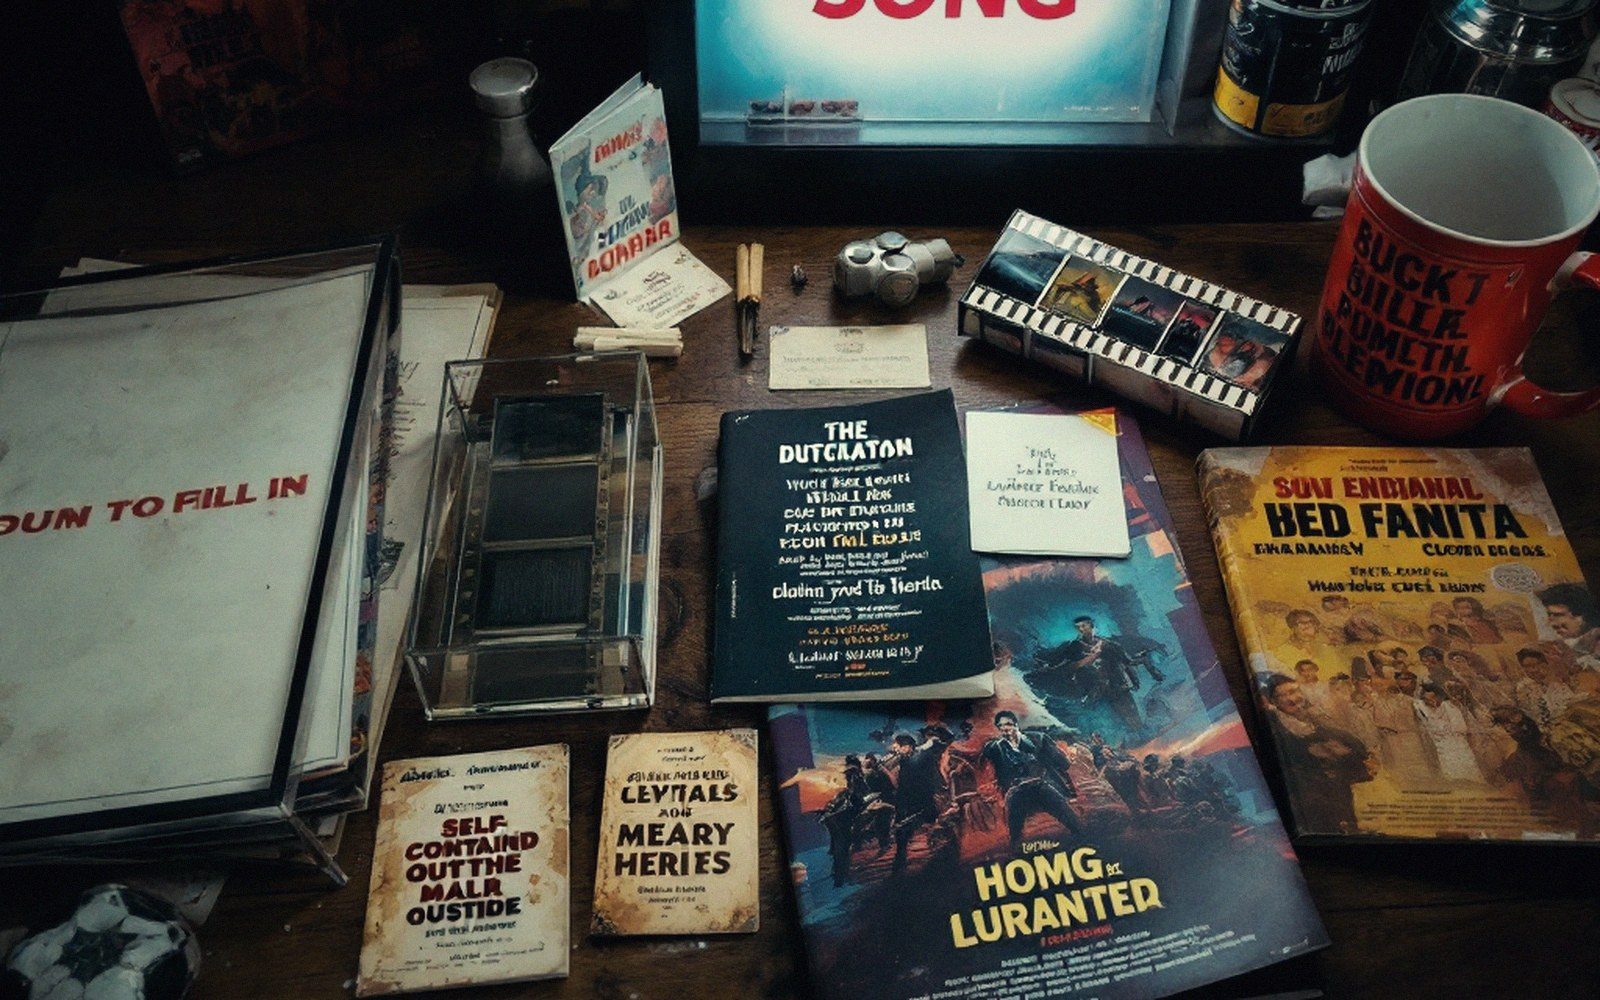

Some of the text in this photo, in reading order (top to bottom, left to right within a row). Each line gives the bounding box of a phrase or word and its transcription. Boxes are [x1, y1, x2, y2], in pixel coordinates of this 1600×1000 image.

[824, 420, 869, 441] THE
[107, 496, 165, 522] TO
[267, 474, 309, 500] IN
[1360, 502, 1529, 539] FANITA
[617, 822, 735, 847] MEARY
[974, 847, 1104, 901] HOMG
